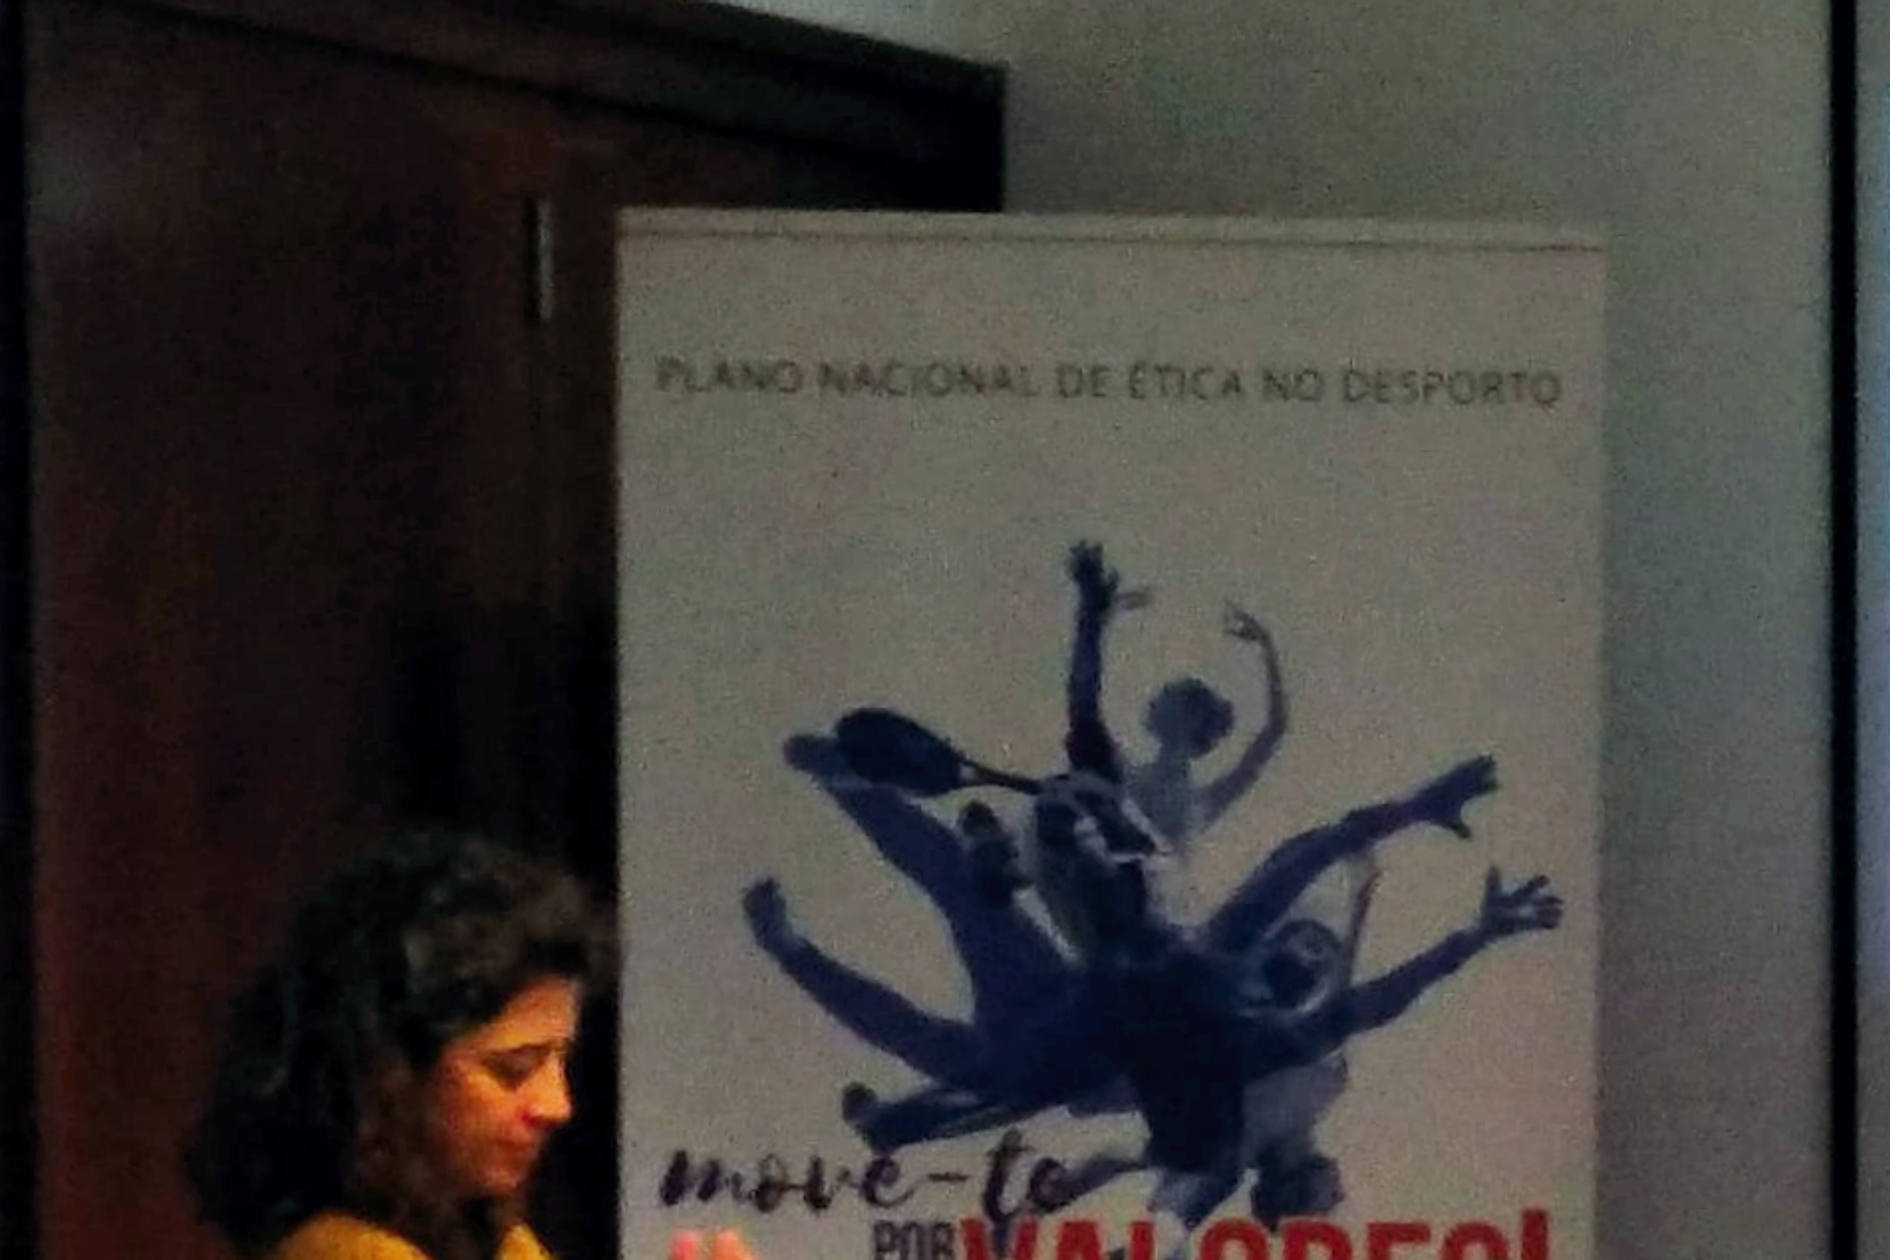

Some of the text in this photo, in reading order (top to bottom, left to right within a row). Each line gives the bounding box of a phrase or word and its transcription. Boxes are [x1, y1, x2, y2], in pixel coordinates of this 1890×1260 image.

[655, 355, 805, 393] PLANO
[817, 361, 1038, 398] NACIONAL
[1056, 364, 1110, 398] DE
[1263, 367, 1324, 401] NO
[1343, 369, 1562, 407] DESPORTO
